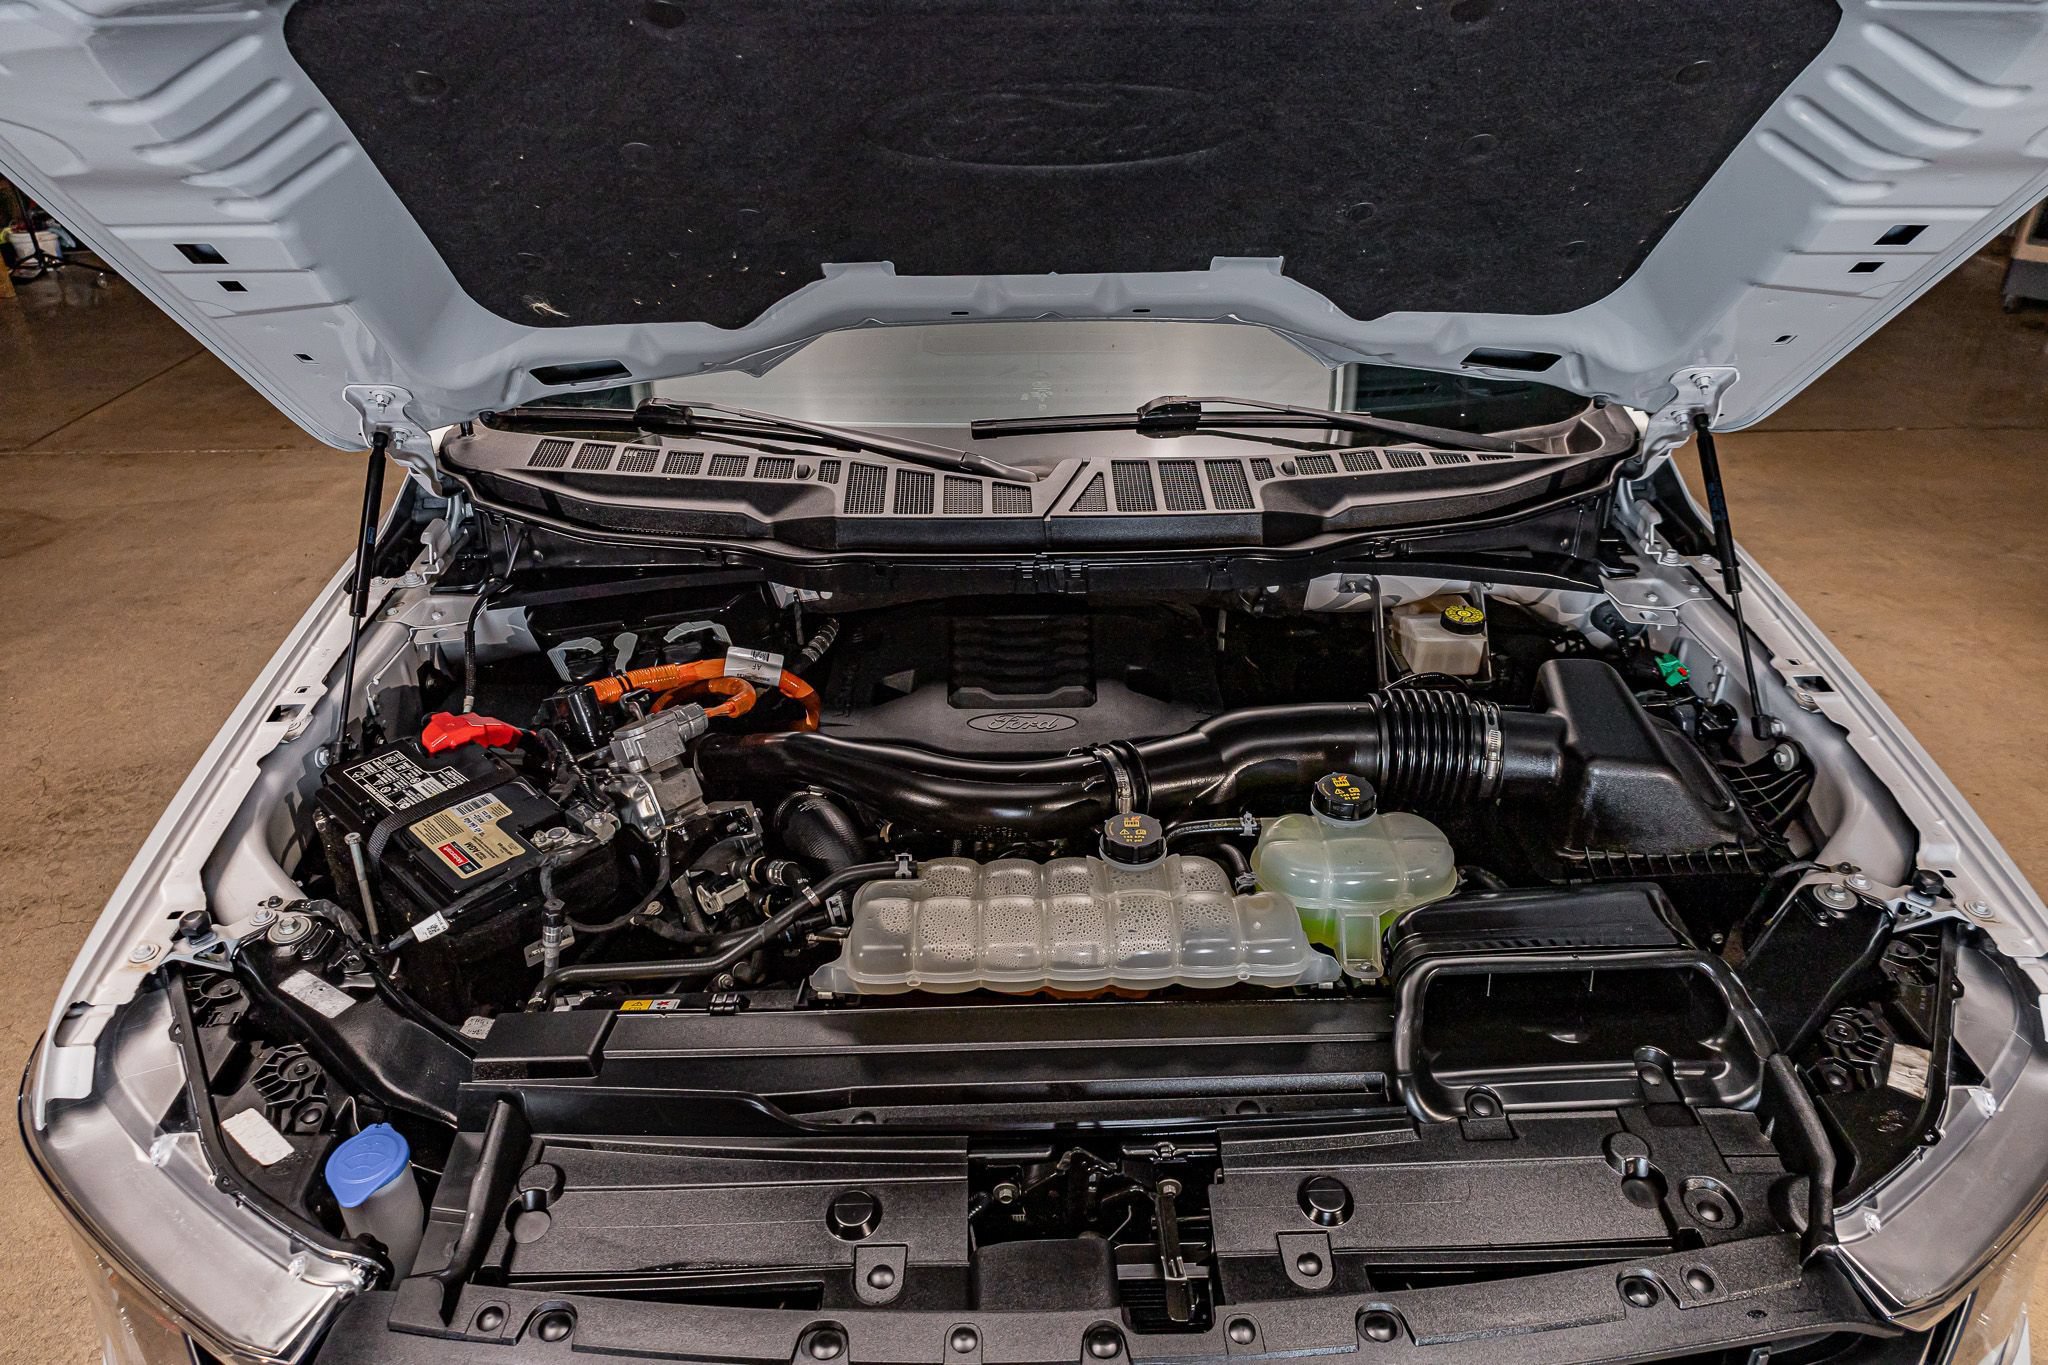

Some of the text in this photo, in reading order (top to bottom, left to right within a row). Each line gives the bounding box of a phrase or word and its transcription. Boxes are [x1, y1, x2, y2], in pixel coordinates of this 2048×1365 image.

[752, 663, 762, 671] AF
[987, 714, 1059, 730] Ford
[464, 841, 481, 853] AGM
